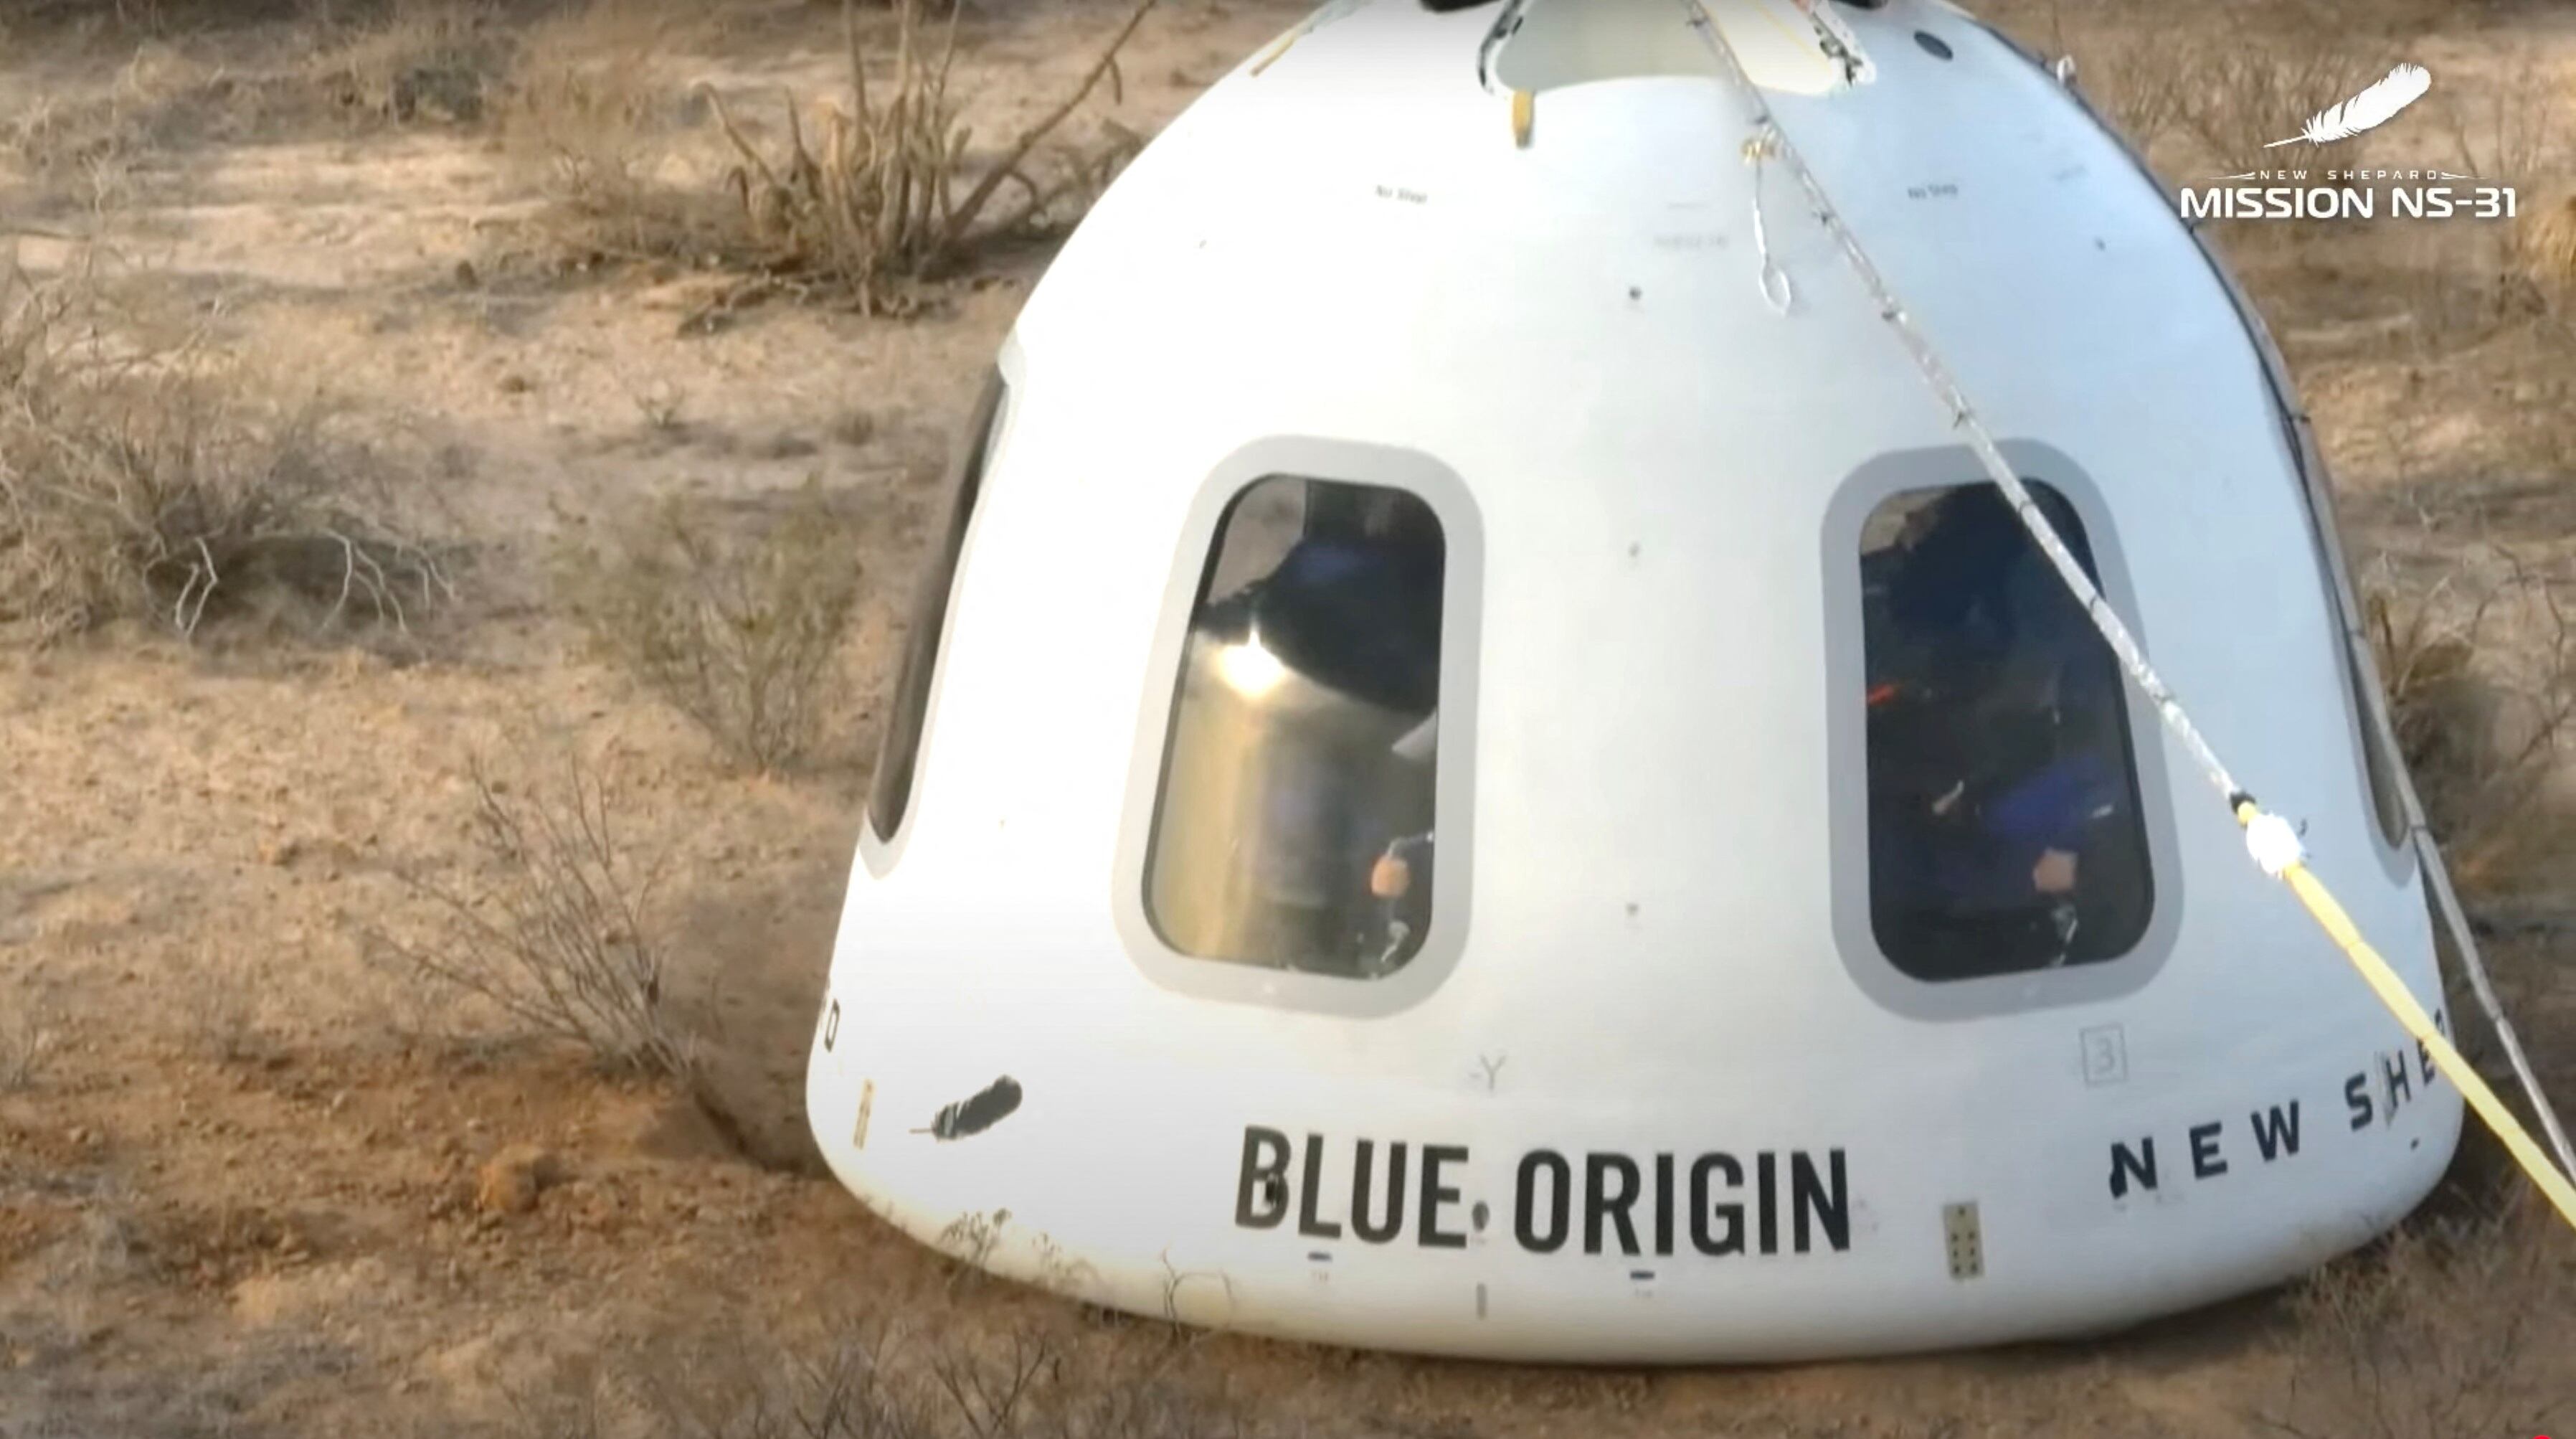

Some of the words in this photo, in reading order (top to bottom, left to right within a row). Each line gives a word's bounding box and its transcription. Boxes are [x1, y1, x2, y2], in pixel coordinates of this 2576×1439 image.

[2094, 1037, 2116, 1076] 3
[1234, 1126, 1469, 1249] BLUE
[1514, 1148, 1850, 1258] ORIGIN
[2109, 1100, 2299, 1199] NEW
